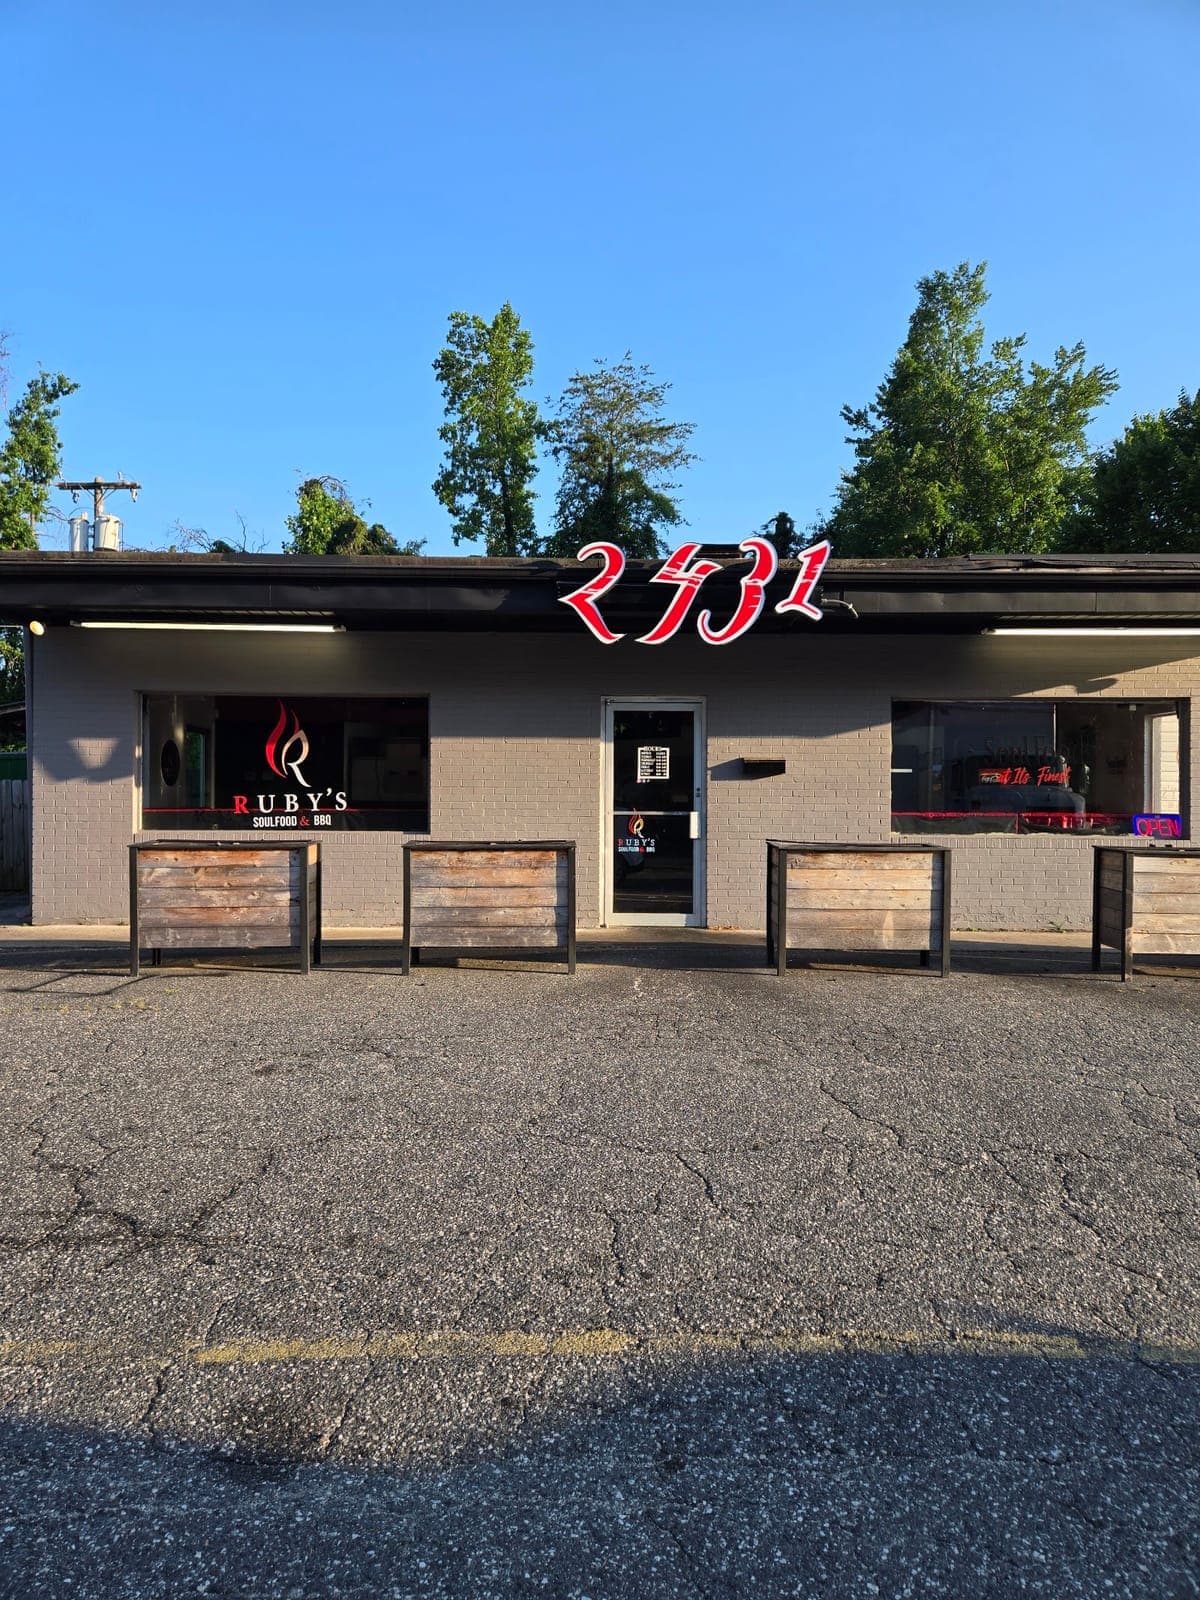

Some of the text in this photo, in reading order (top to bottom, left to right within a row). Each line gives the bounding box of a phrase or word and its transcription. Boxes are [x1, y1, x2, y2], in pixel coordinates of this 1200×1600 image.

[557, 537, 831, 645] 2431
[1011, 767, 1030, 785] Its
[1037, 766, 1071, 787] Finest
[232, 787, 348, 815] RUBY'S
[252, 815, 298, 828] SOULFOOD
[313, 814, 332, 826] BBQ
[1136, 818, 1180, 837] OPEN
